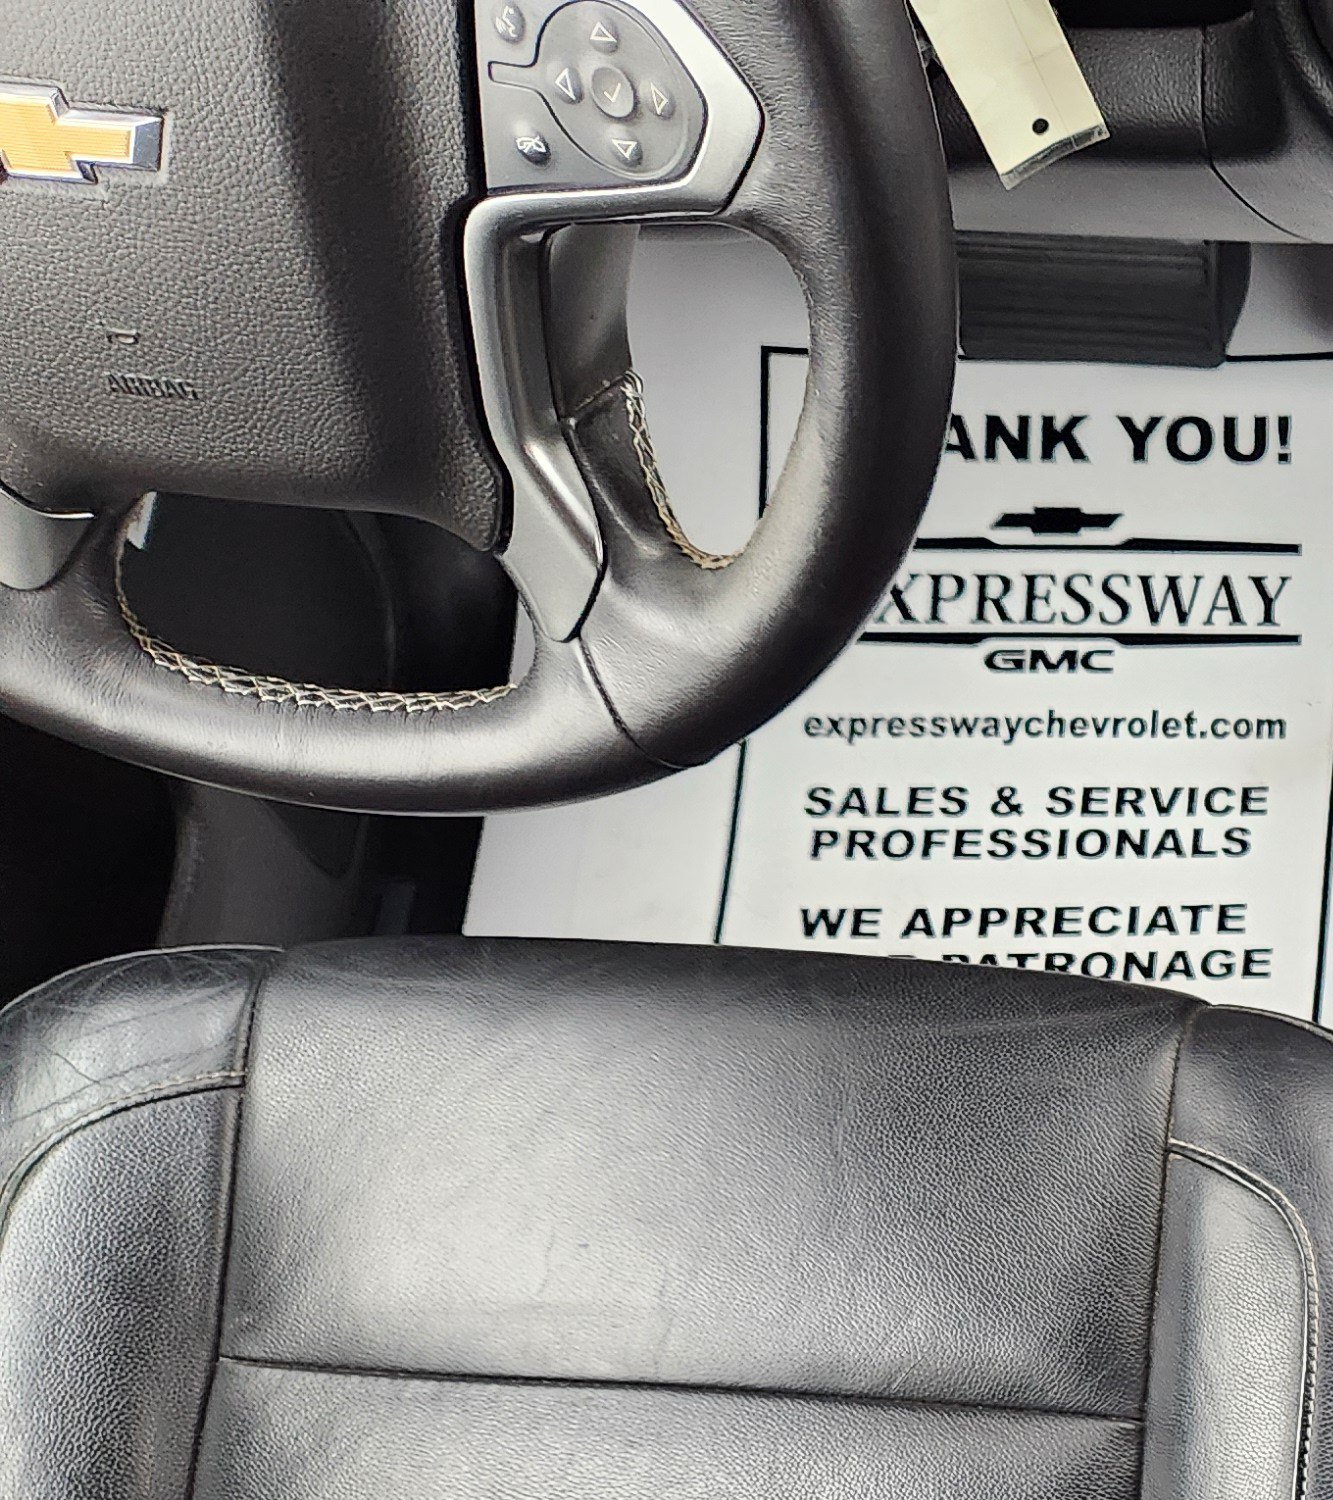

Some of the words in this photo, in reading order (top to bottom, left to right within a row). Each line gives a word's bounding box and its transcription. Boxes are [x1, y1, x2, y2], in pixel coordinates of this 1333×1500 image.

[106, 373, 200, 401] AIRBAG
[942, 414, 1092, 463] ANK
[1115, 415, 1293, 464] YOU!
[874, 573, 1293, 627] XPRESSWAY
[984, 649, 1115, 674] GMC
[804, 709, 1287, 743] expresswaychevrolet.com
[804, 786, 970, 819] SALES
[990, 786, 1025, 818] &
[1046, 786, 1271, 817] SERVICE
[811, 827, 1253, 861] PROFESSIONALS
[801, 907, 882, 939] WE
[900, 903, 1248, 939] APPRECIATE
[942, 948, 1274, 981] TRONAGE
